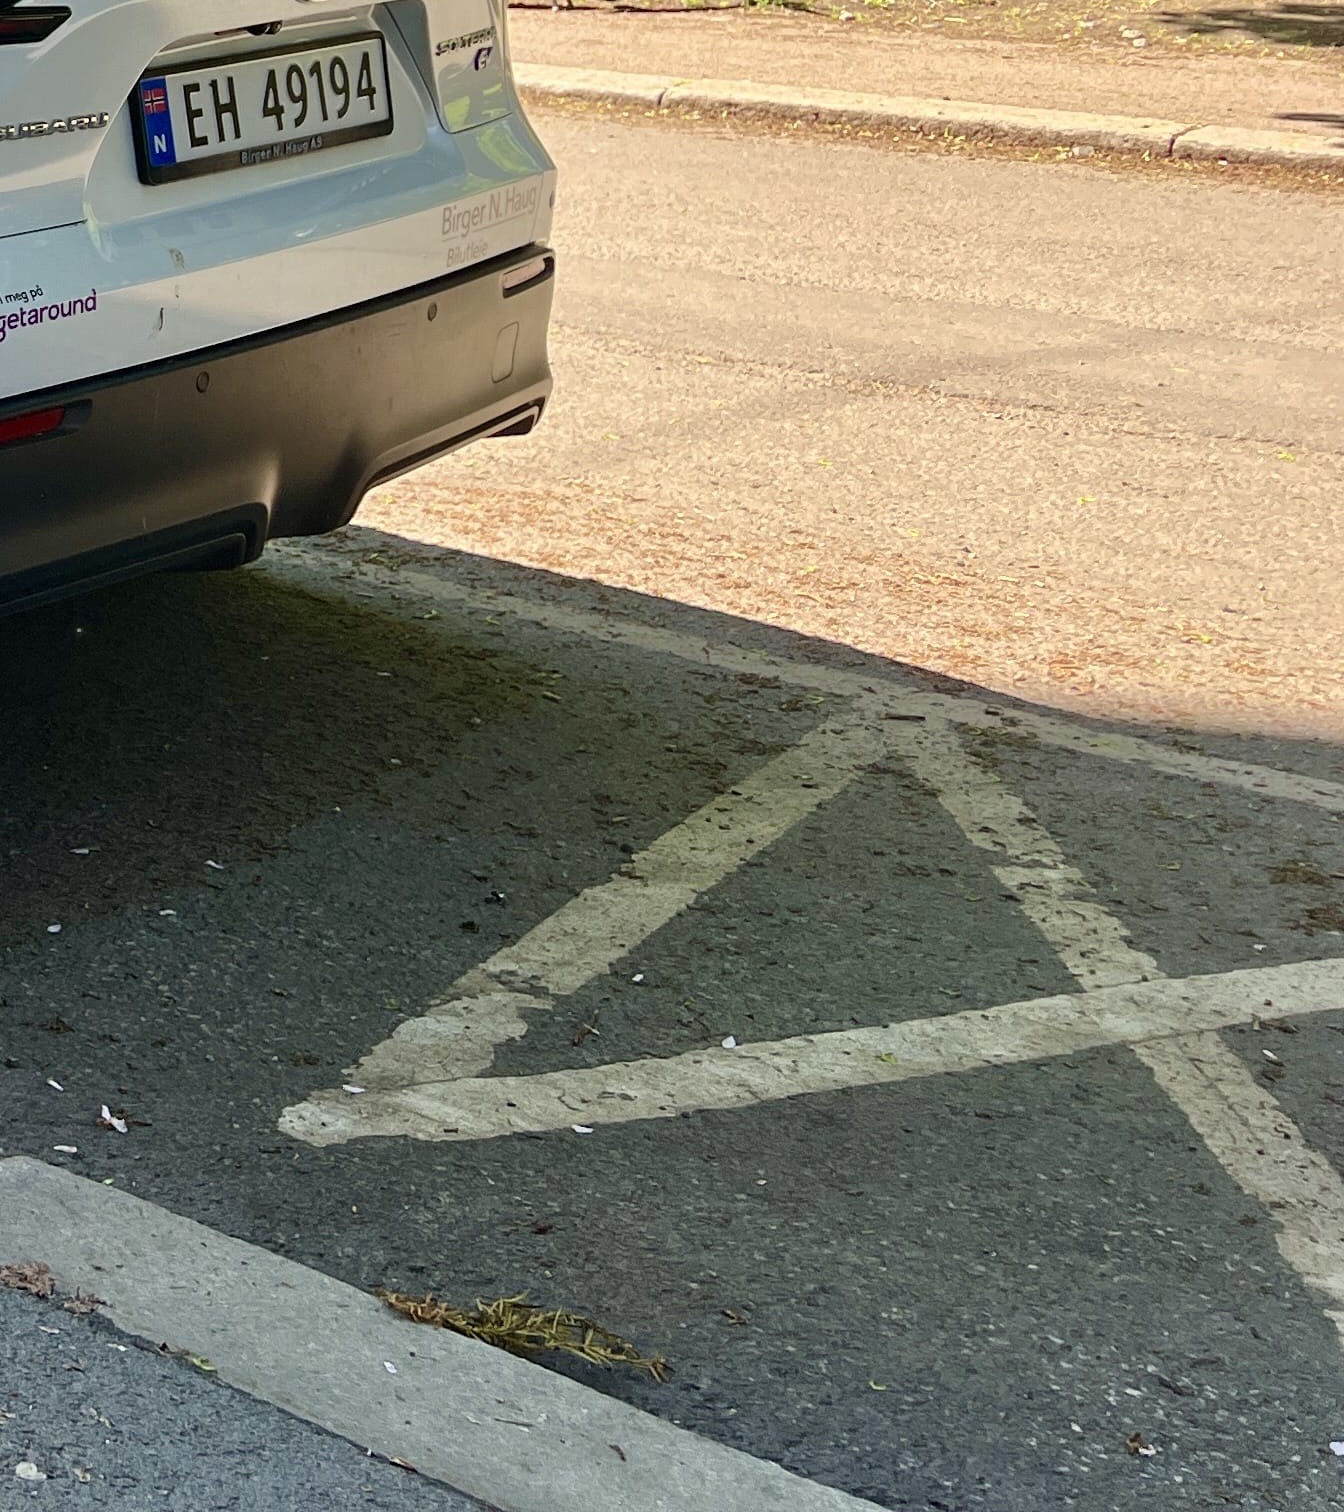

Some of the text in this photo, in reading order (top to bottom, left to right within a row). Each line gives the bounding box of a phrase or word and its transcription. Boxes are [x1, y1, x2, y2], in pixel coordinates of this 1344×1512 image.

[183, 50, 377, 149] EH 49194
[153, 133, 167, 155] N
[441, 205, 487, 238] Birger
[505, 186, 537, 214] Haug
[446, 239, 489, 268] Bilutleie
[5, 291, 29, 303] meg
[29, 284, 44, 301] på
